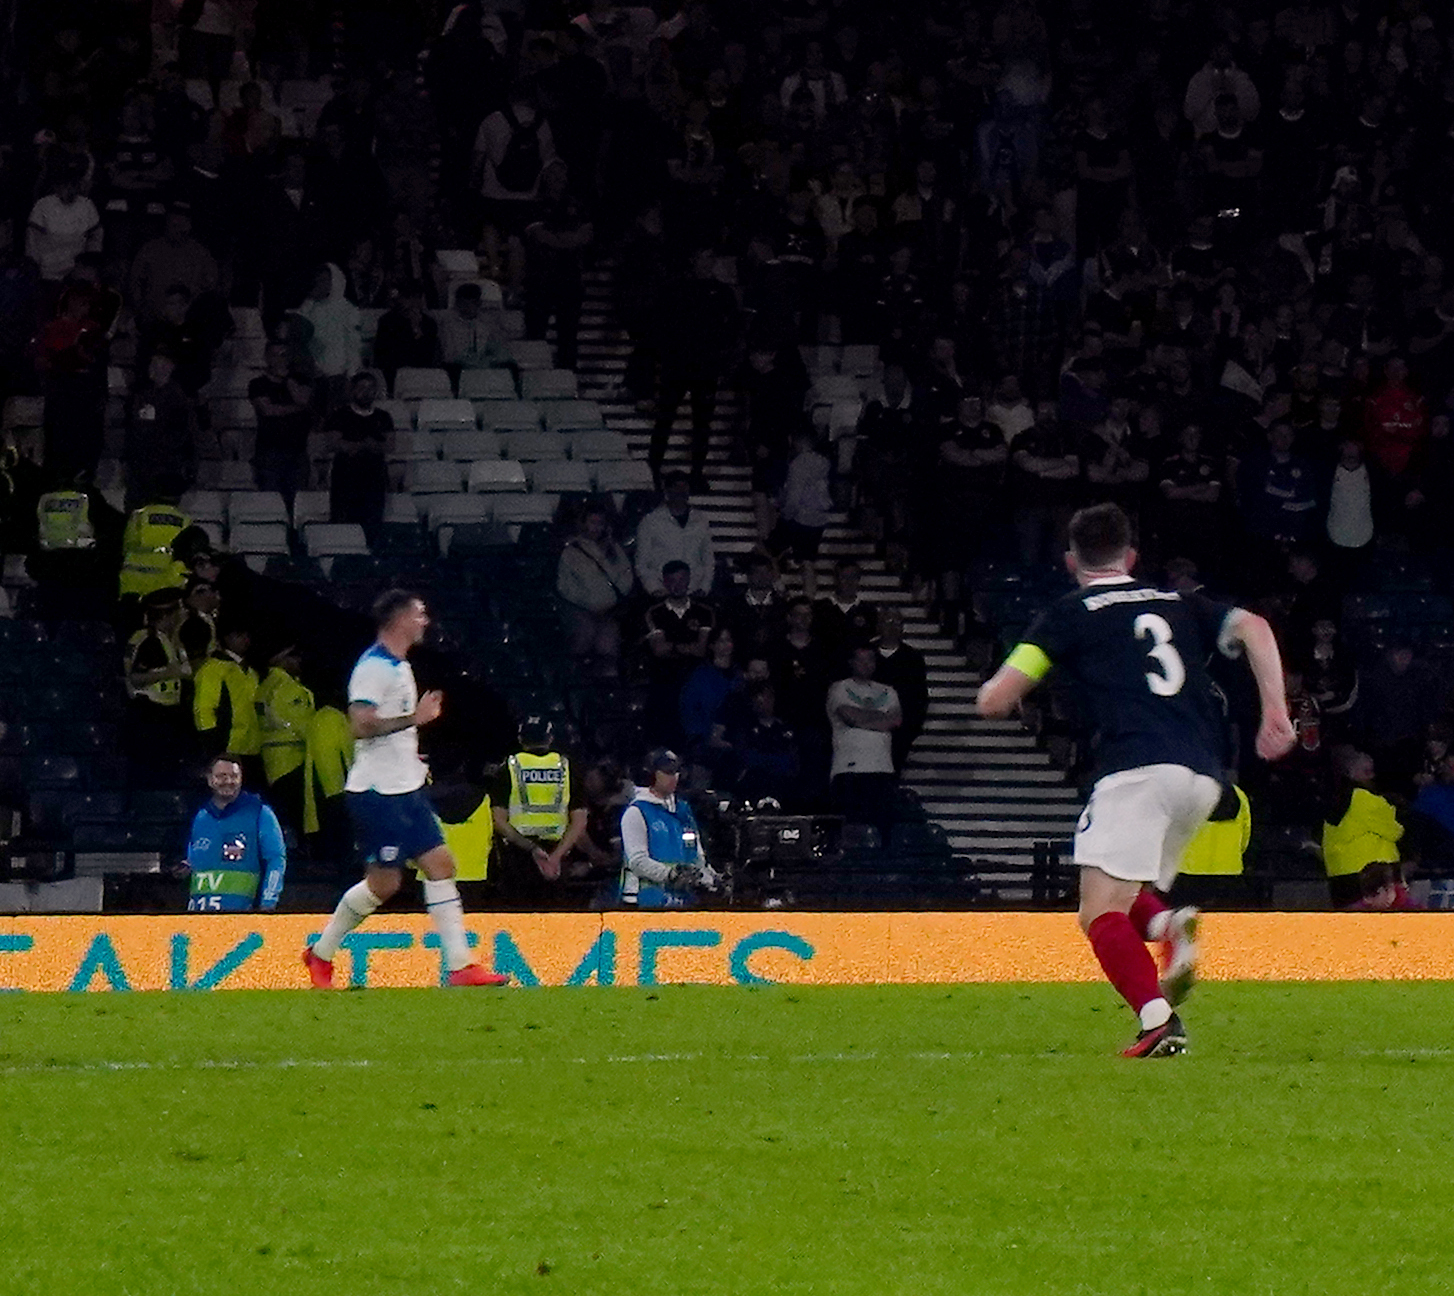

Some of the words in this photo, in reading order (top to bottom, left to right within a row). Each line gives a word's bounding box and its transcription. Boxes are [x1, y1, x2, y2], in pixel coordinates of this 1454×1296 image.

[1133, 612, 1187, 697] 3
[522, 769, 562, 783] POLICE
[196, 872, 225, 891] TV
[0, 931, 264, 992] AK
